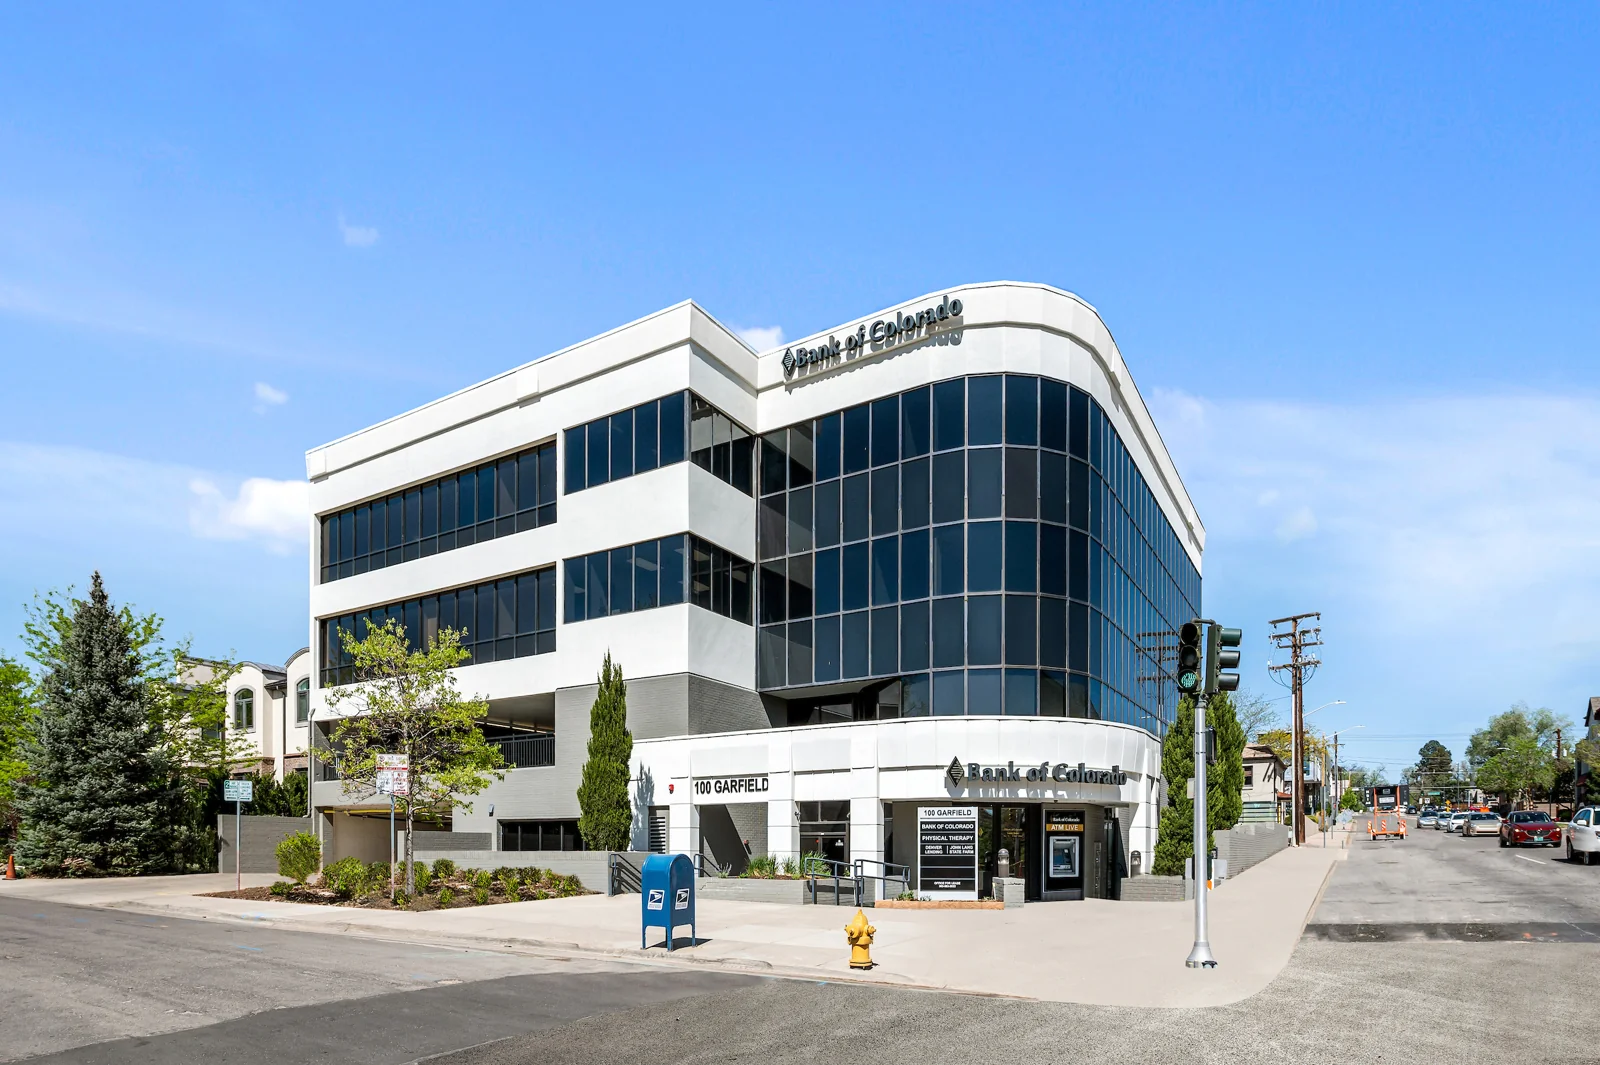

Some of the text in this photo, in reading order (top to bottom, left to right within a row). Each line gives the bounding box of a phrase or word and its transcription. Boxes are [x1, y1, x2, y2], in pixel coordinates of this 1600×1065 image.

[795, 295, 964, 369] Bank of Colorado
[967, 761, 1127, 785] Bank of Colorado
[694, 777, 769, 795] 100 GARFIELD
[924, 809, 935, 817] 100
